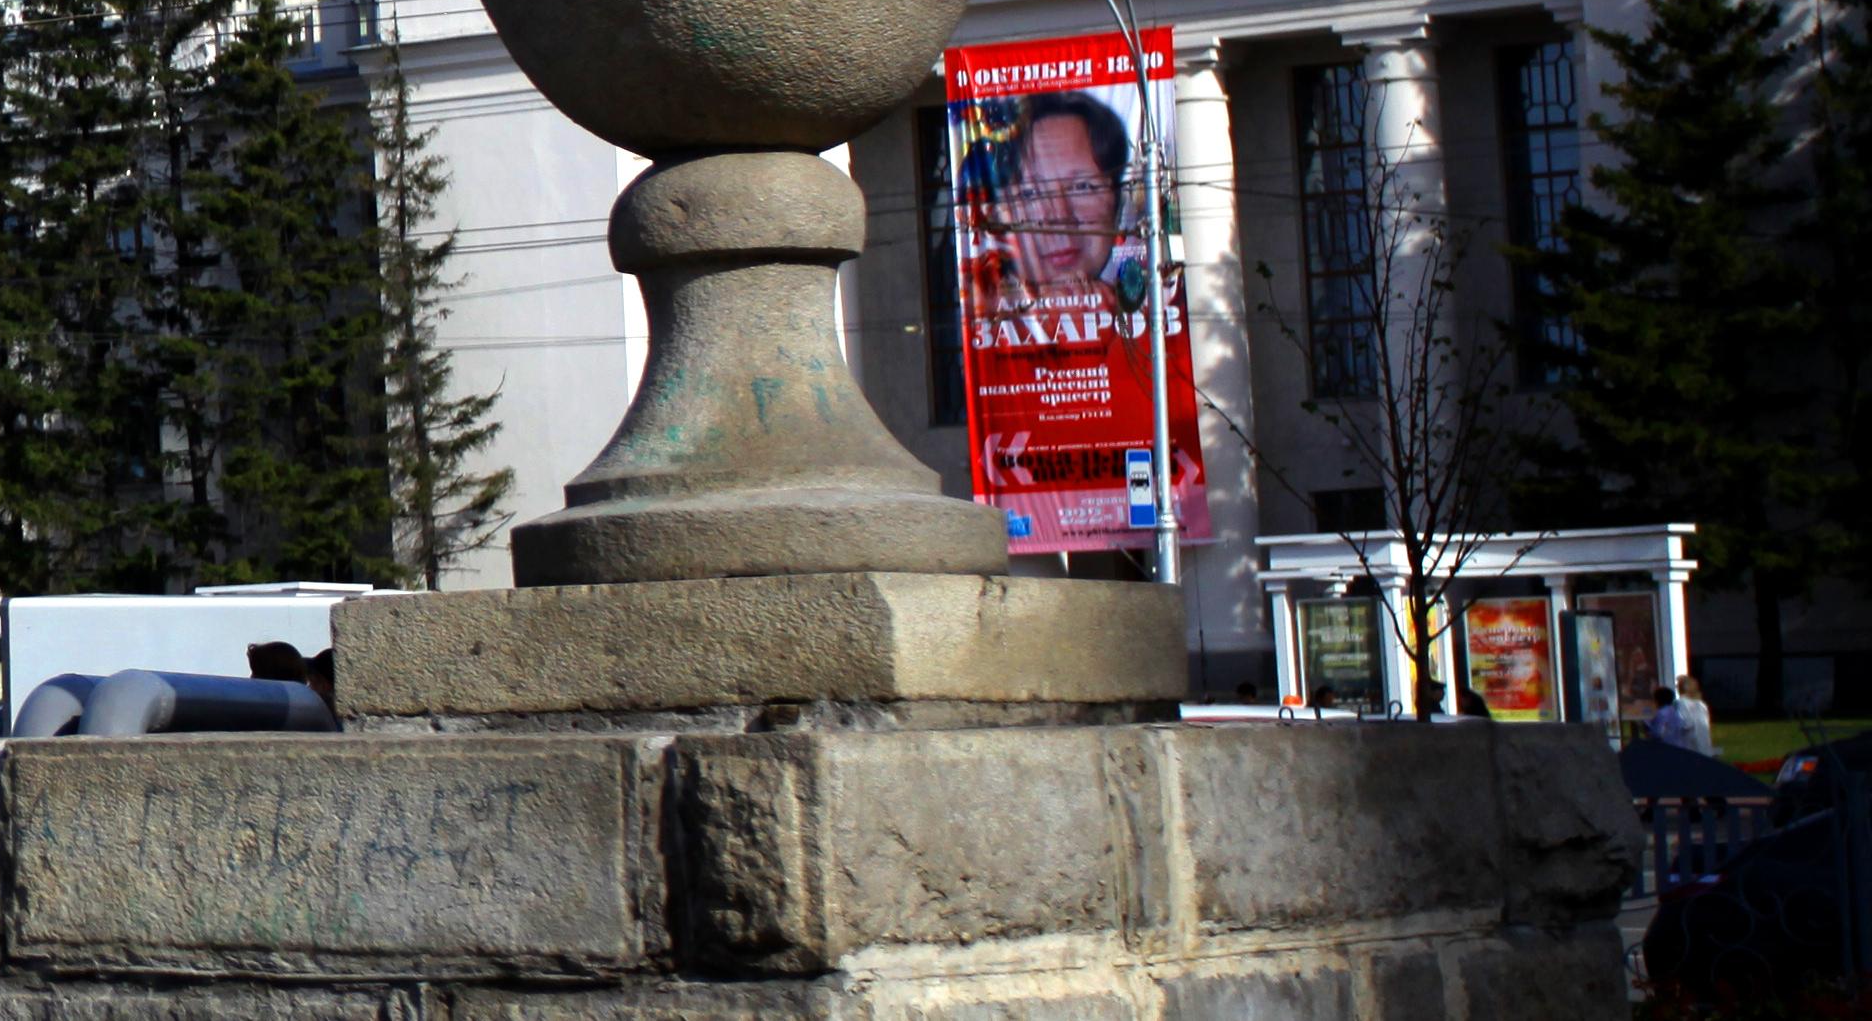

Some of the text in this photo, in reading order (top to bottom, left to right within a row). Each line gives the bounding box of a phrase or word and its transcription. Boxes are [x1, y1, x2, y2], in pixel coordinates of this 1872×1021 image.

[974, 57, 1092, 85] ОКТЯБРЯ
[1035, 364, 1109, 380] Русский
[979, 378, 1109, 397] академический
[1040, 390, 1112, 405] оркестр
